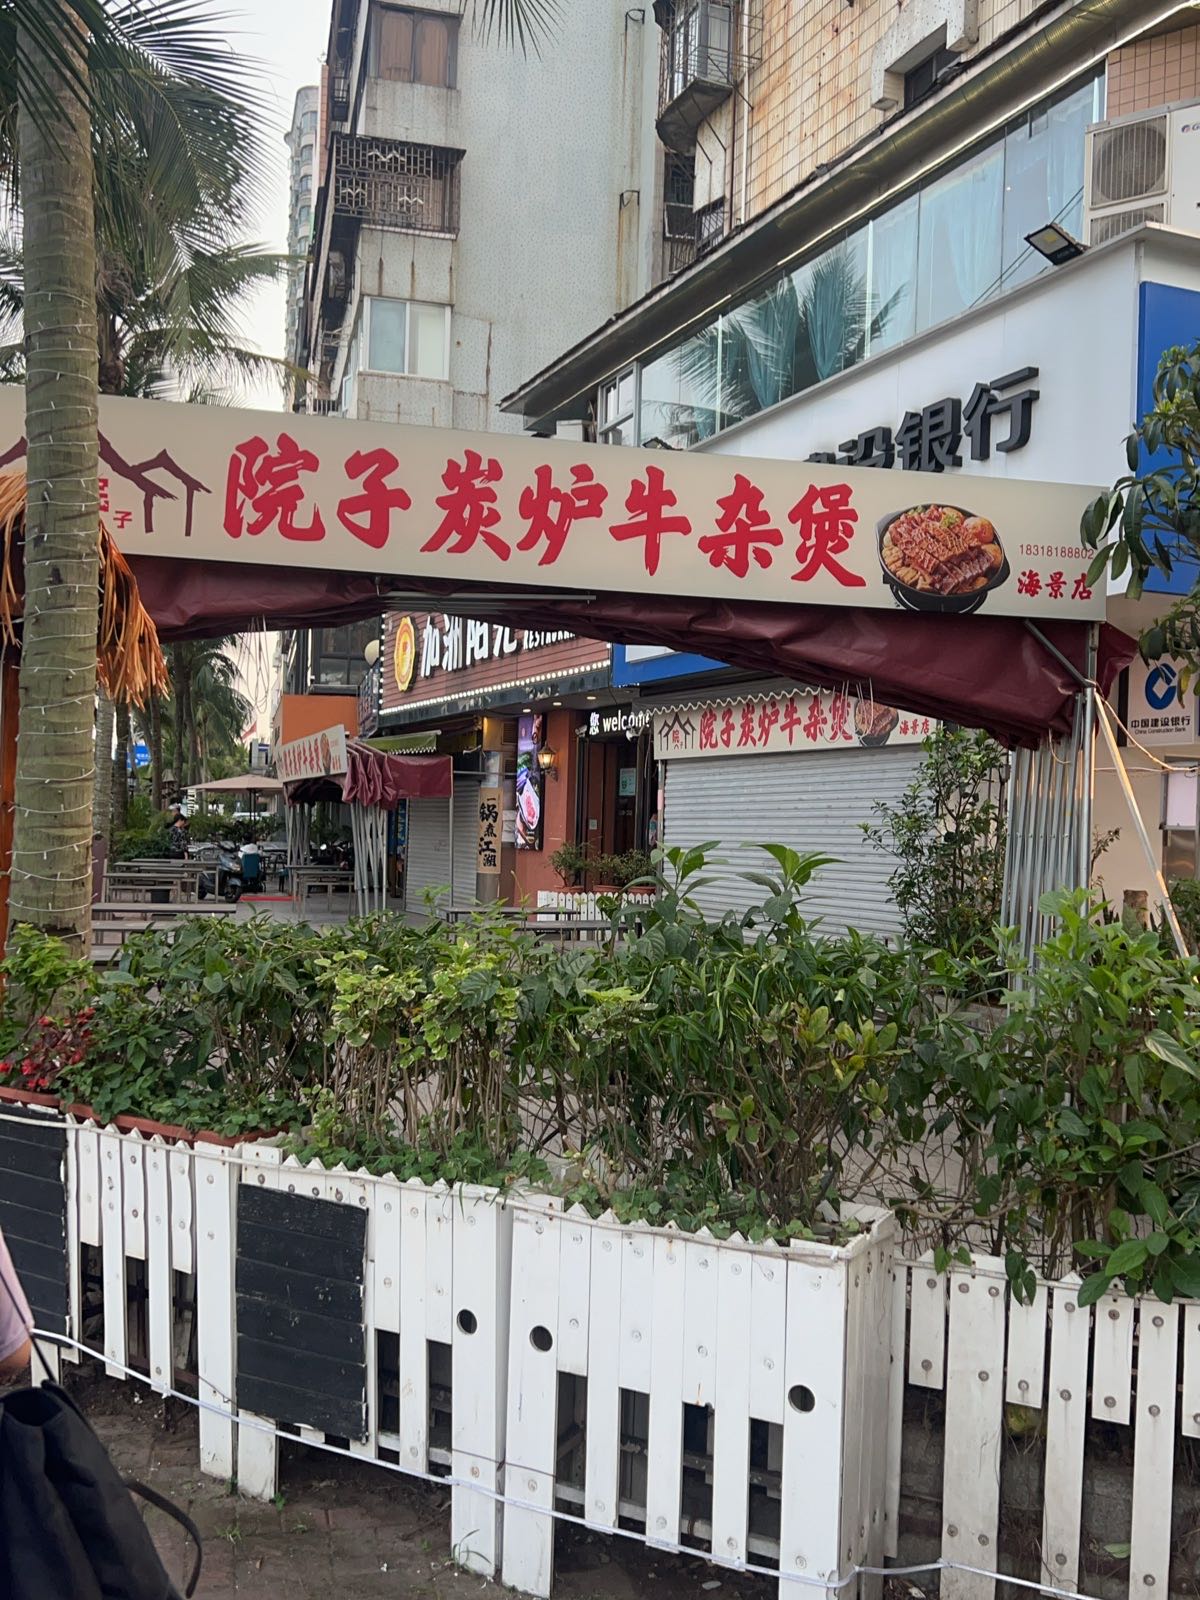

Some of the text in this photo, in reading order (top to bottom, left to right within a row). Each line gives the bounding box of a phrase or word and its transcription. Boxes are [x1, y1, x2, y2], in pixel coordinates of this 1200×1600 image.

[803, 366, 1040, 473] 设银行
[223, 433, 866, 588] 院子炭炉牛杂煲
[1020, 544, 1095, 560] 18318188802
[1017, 569, 1092, 600] 海景店
[699, 693, 853, 751] 院子炭炉牛杂煲
[1131, 715, 1191, 728] 中国建设银行
[479, 797, 498, 867] 一锅煮江湖
